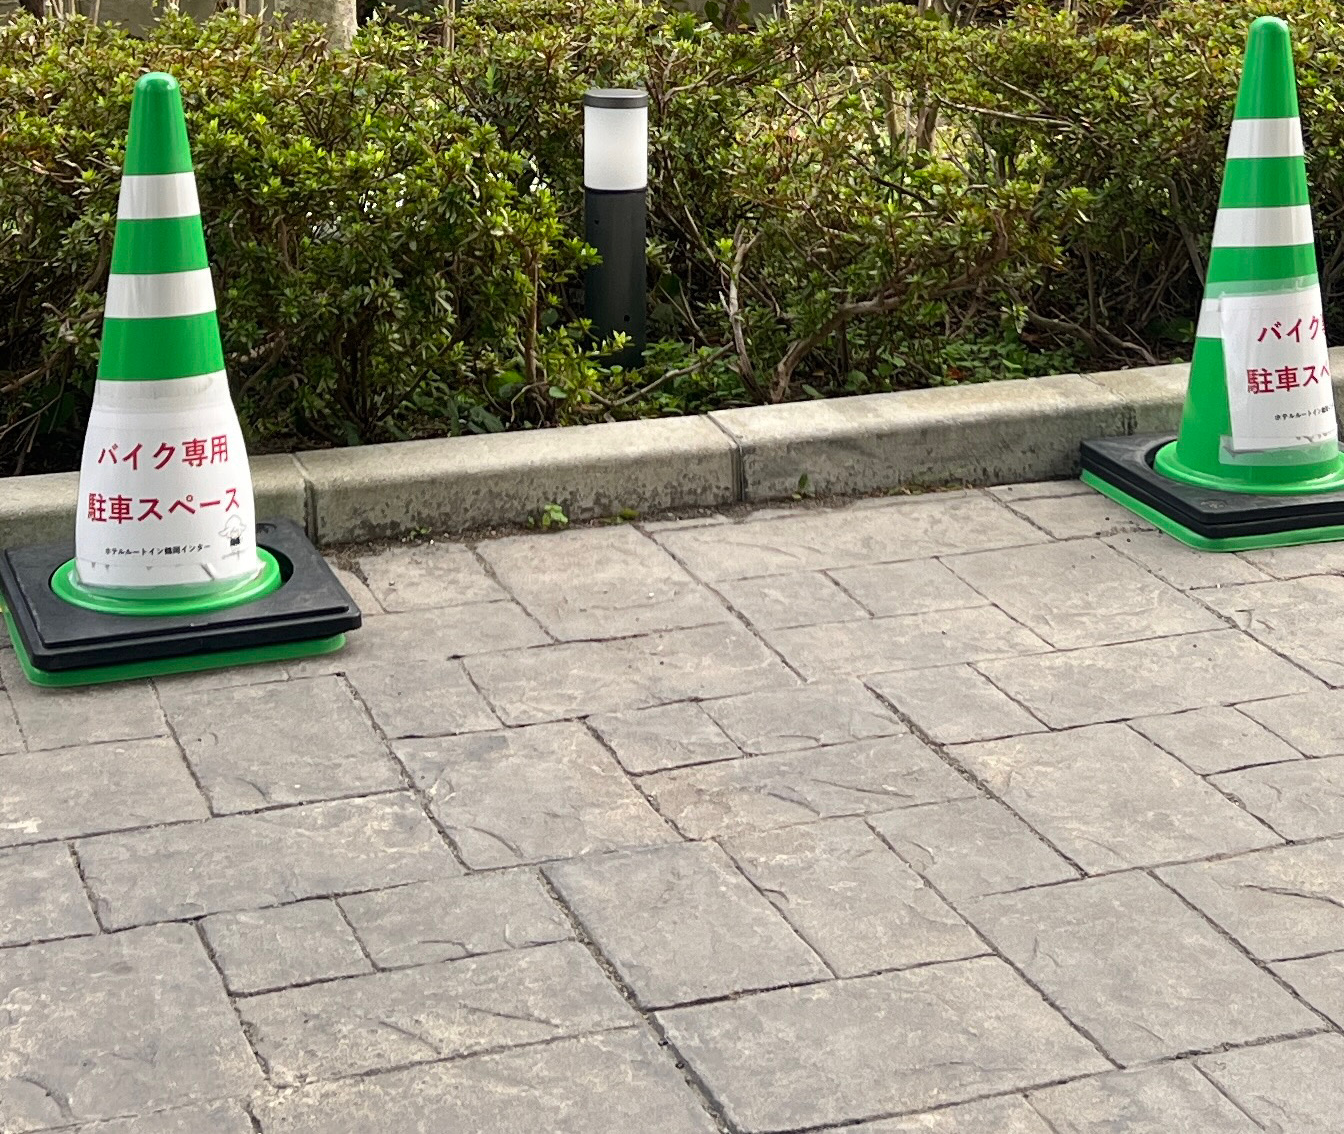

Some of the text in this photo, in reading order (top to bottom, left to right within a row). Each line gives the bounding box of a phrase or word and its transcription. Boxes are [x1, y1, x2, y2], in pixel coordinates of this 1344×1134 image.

[1257, 313, 1326, 343] バイク
[97, 434, 229, 471] バイク専用
[87, 487, 240, 525] 駐車スペース
